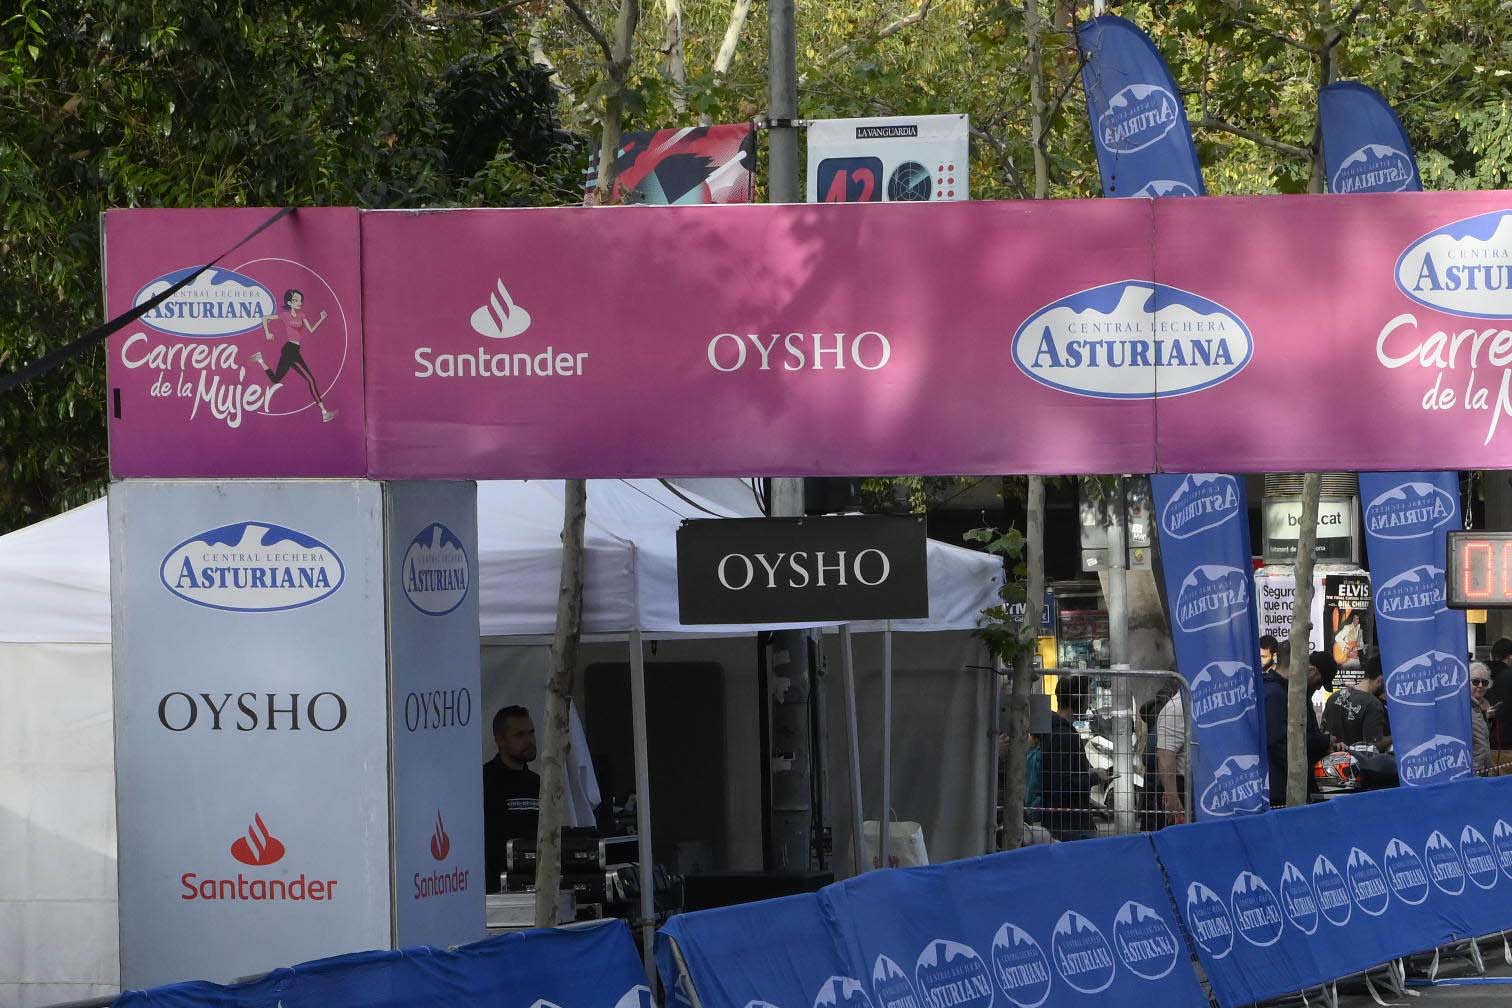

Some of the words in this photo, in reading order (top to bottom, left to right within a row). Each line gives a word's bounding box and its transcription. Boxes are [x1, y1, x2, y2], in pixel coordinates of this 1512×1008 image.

[172, 290, 209, 298] ENTRAL
[1067, 321, 1144, 334] CENTRAL
[1150, 320, 1226, 333] LECHERA
[121, 332, 239, 370] Carrera
[414, 346, 589, 379] Santander
[707, 330, 891, 372] OYSHO
[1031, 325, 1234, 369] ASTURIANA
[150, 371, 172, 397] de
[177, 371, 192, 397] la
[190, 366, 284, 429] Mujer
[1421, 371, 1456, 410] de
[1464, 370, 1489, 410] la
[175, 555, 331, 589] ASTURIANA
[202, 553, 261, 563] CENTRAL
[266, 552, 325, 562] LECHERA
[407, 556, 466, 593] ASTURIANA
[717, 547, 891, 591] OYSHO
[1263, 601, 1280, 612] que
[1338, 584, 1369, 596] ELVIS
[157, 692, 348, 732] OYSHO
[405, 686, 471, 733] OYSHO
[181, 872, 338, 901] Santander
[414, 867, 469, 900] Santander
